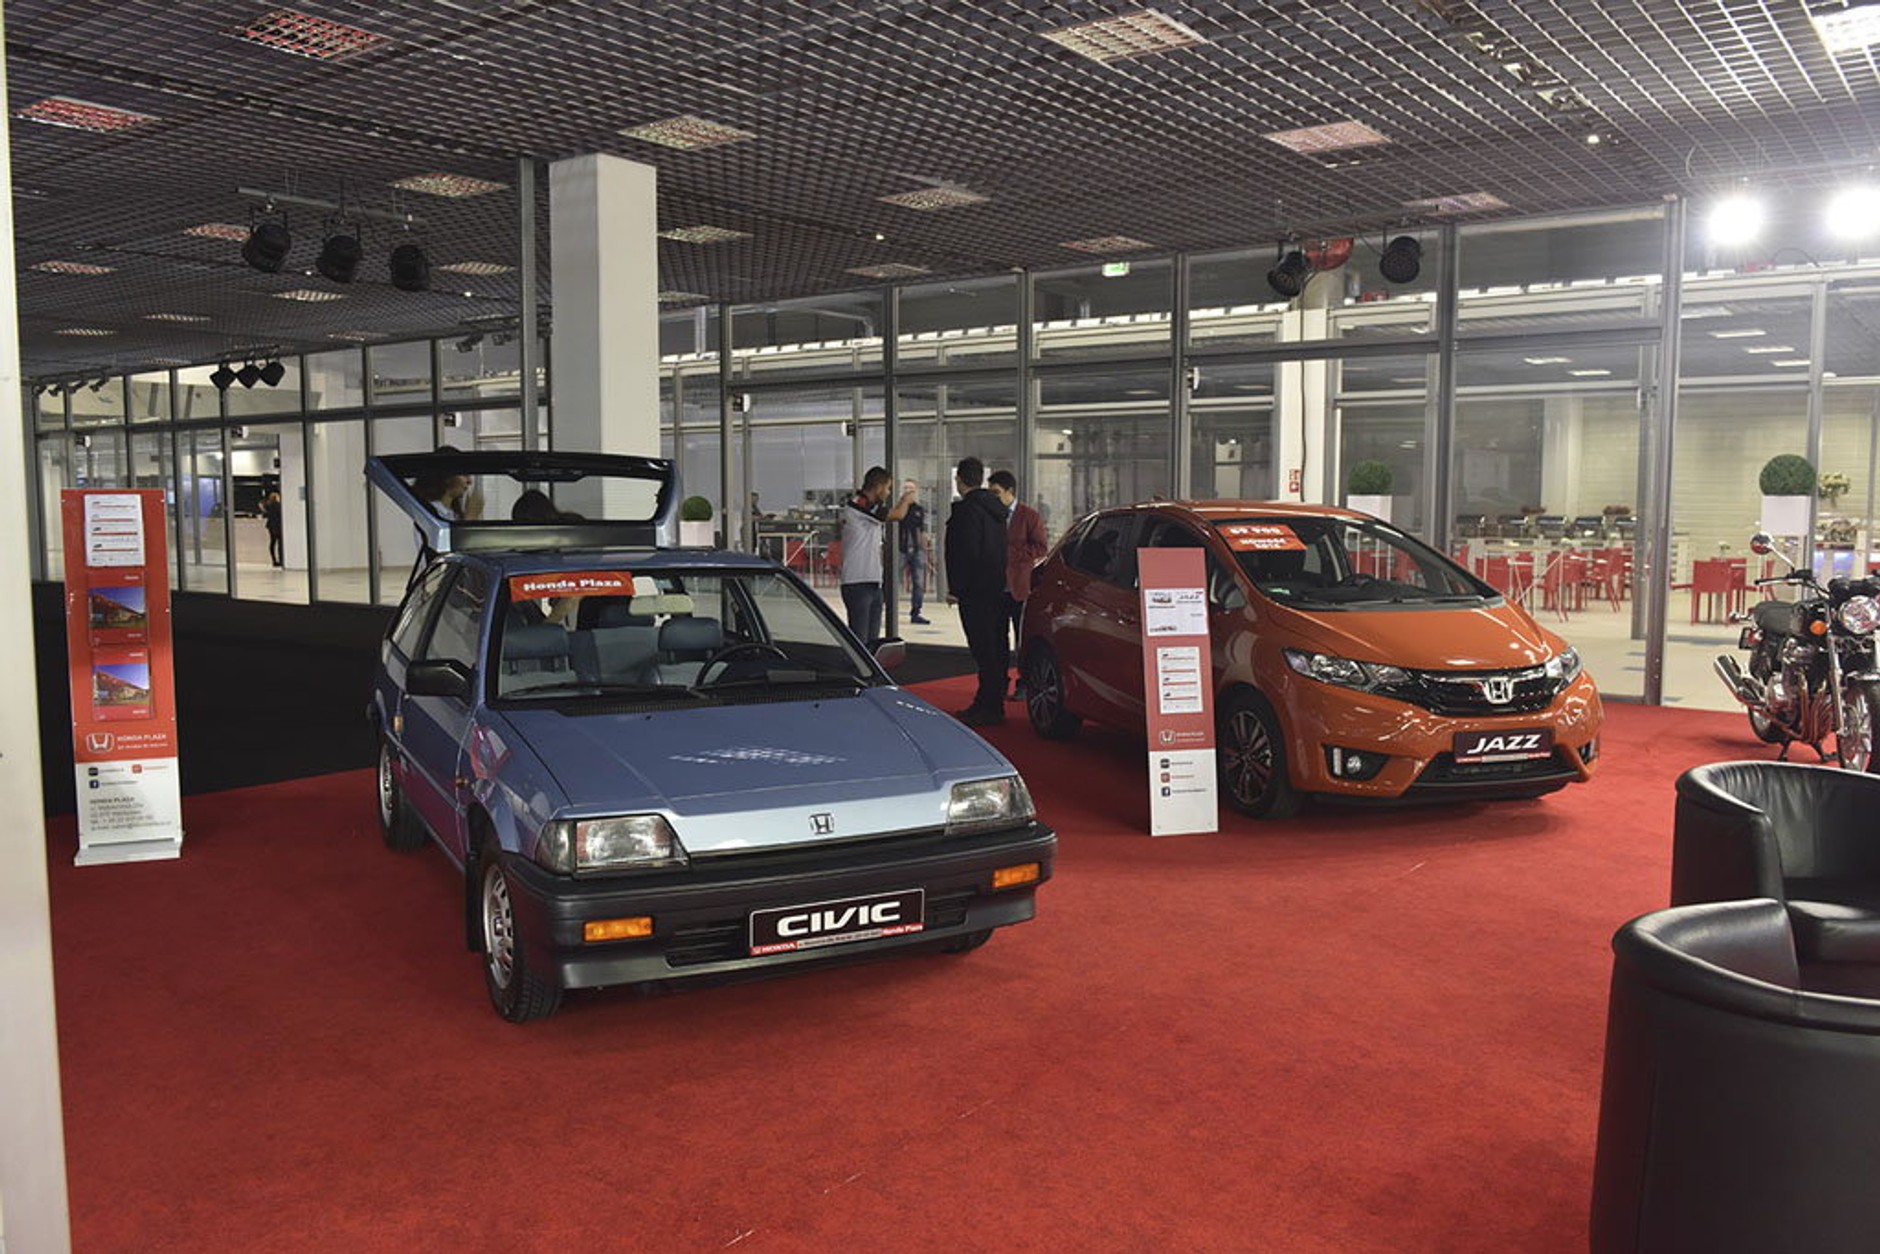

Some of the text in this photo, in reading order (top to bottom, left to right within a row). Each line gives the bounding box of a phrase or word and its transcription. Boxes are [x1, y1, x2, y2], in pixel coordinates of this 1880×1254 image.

[523, 578, 622, 591] Honda Plaza
[1467, 734, 1541, 754] JAZZ
[777, 902, 900, 937] CIVIC
[762, 942, 796, 953] HONDA
